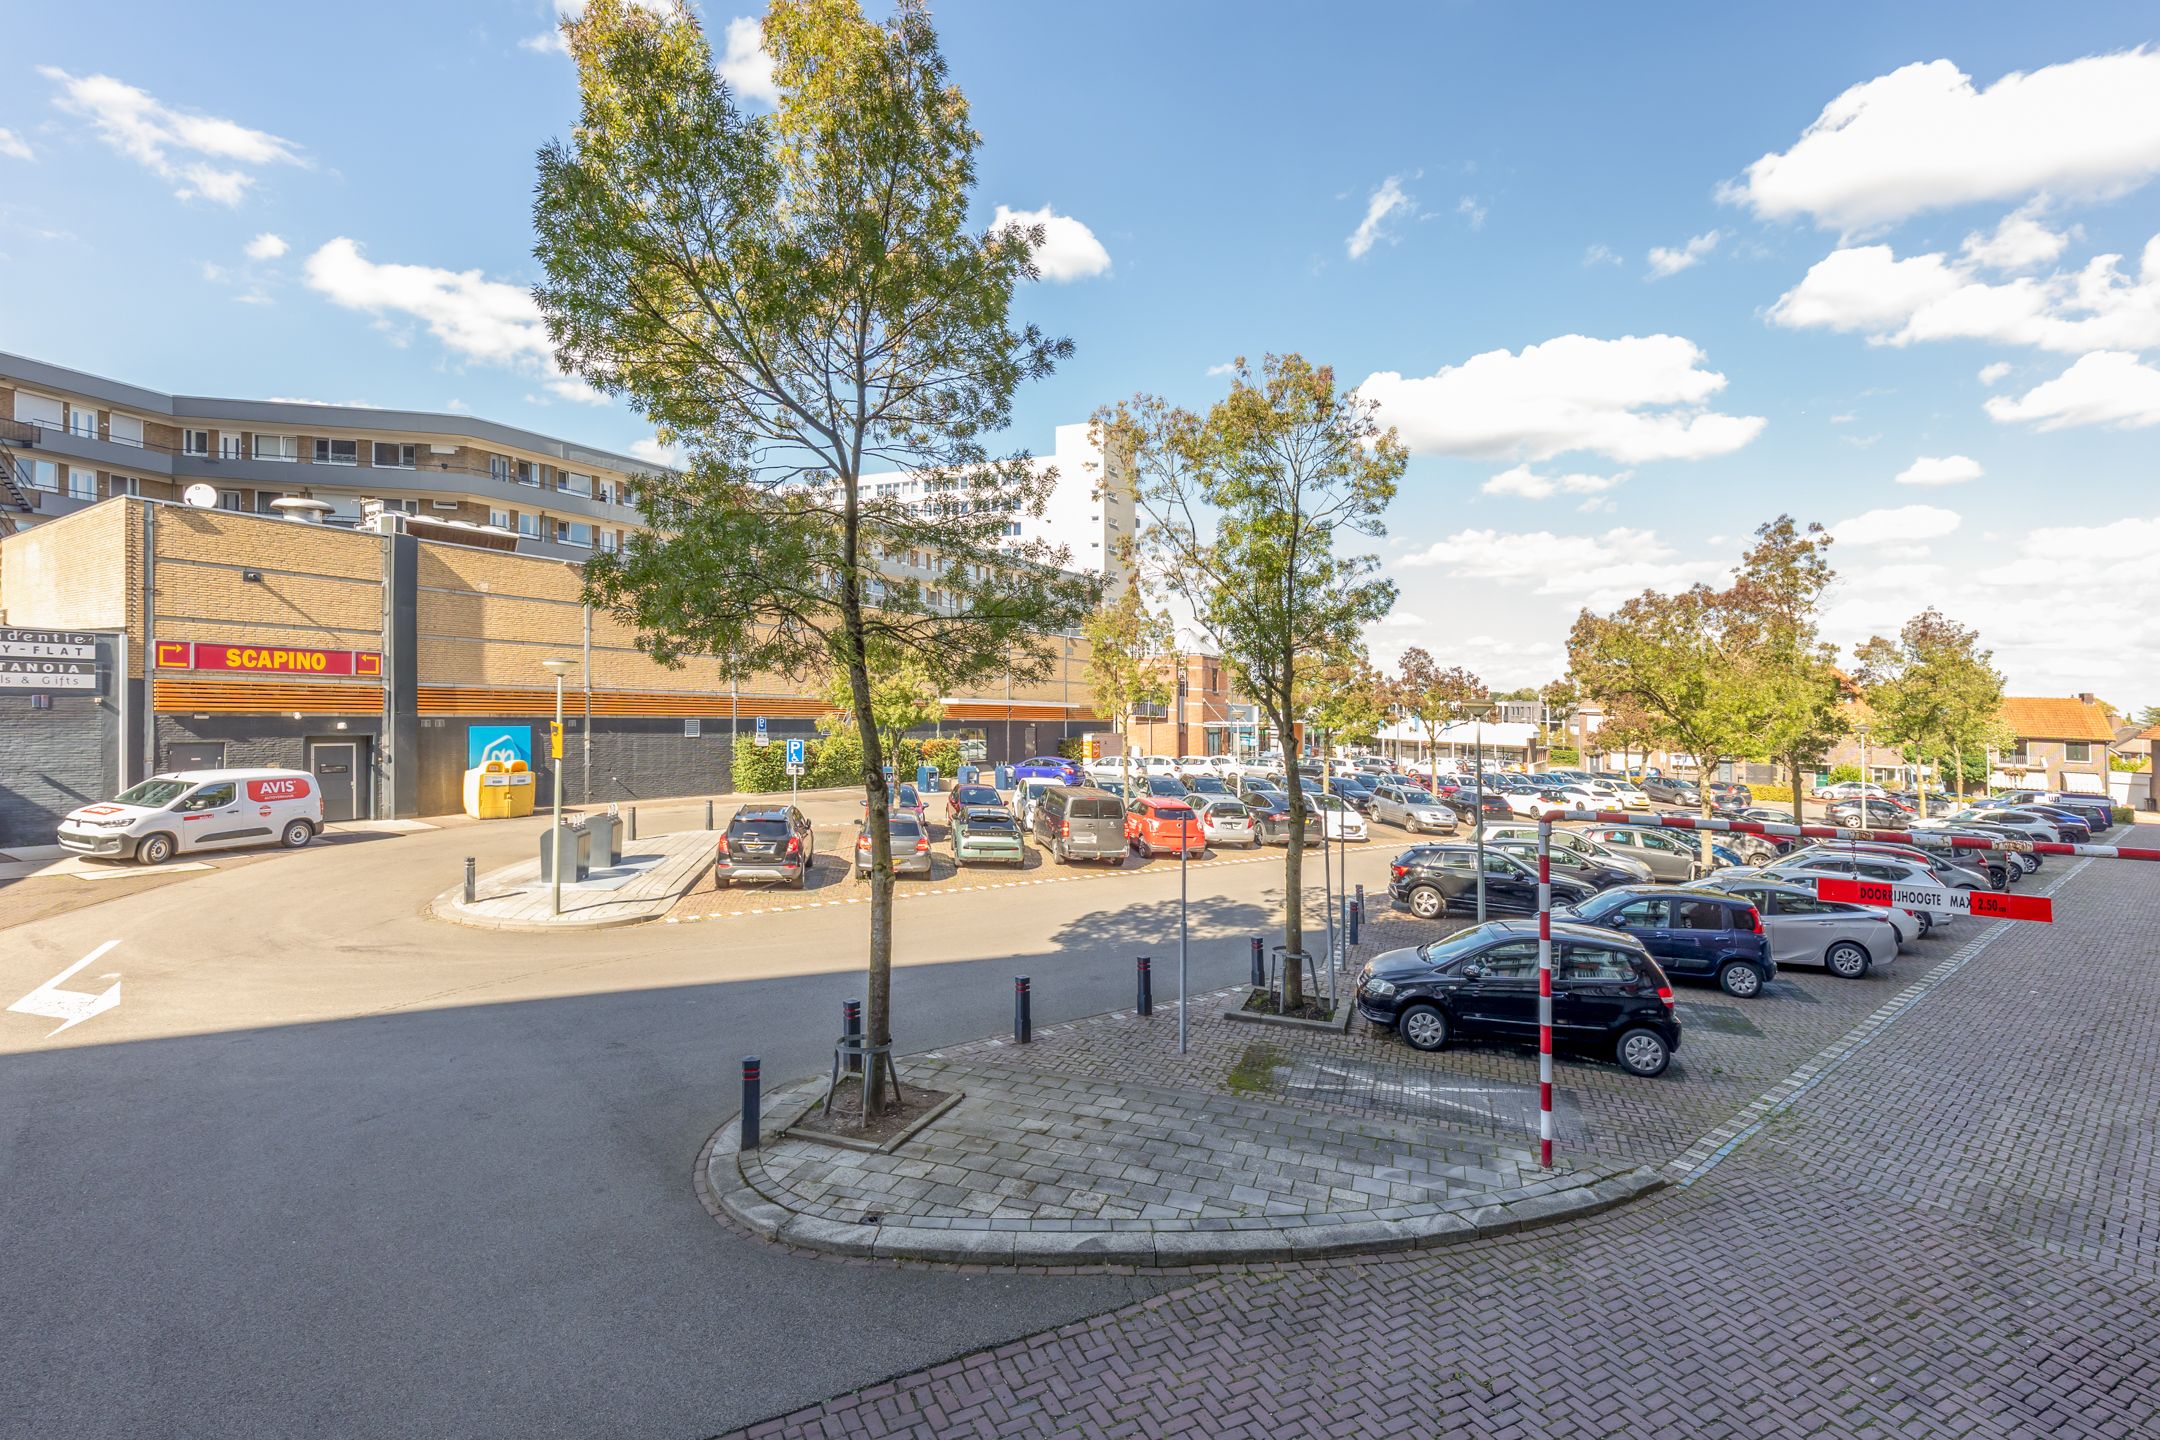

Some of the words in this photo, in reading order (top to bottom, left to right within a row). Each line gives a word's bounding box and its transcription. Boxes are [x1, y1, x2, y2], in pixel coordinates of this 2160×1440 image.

[225, 648, 327, 671] SCAPINO
[20, 676, 30, 685] &
[41, 675, 79, 686] Gifts
[790, 741, 801, 754] P
[260, 780, 295, 794] AVIS
[1859, 887, 1942, 906] DOORRIJHOOGTE
[1950, 895, 1973, 909] MAX
